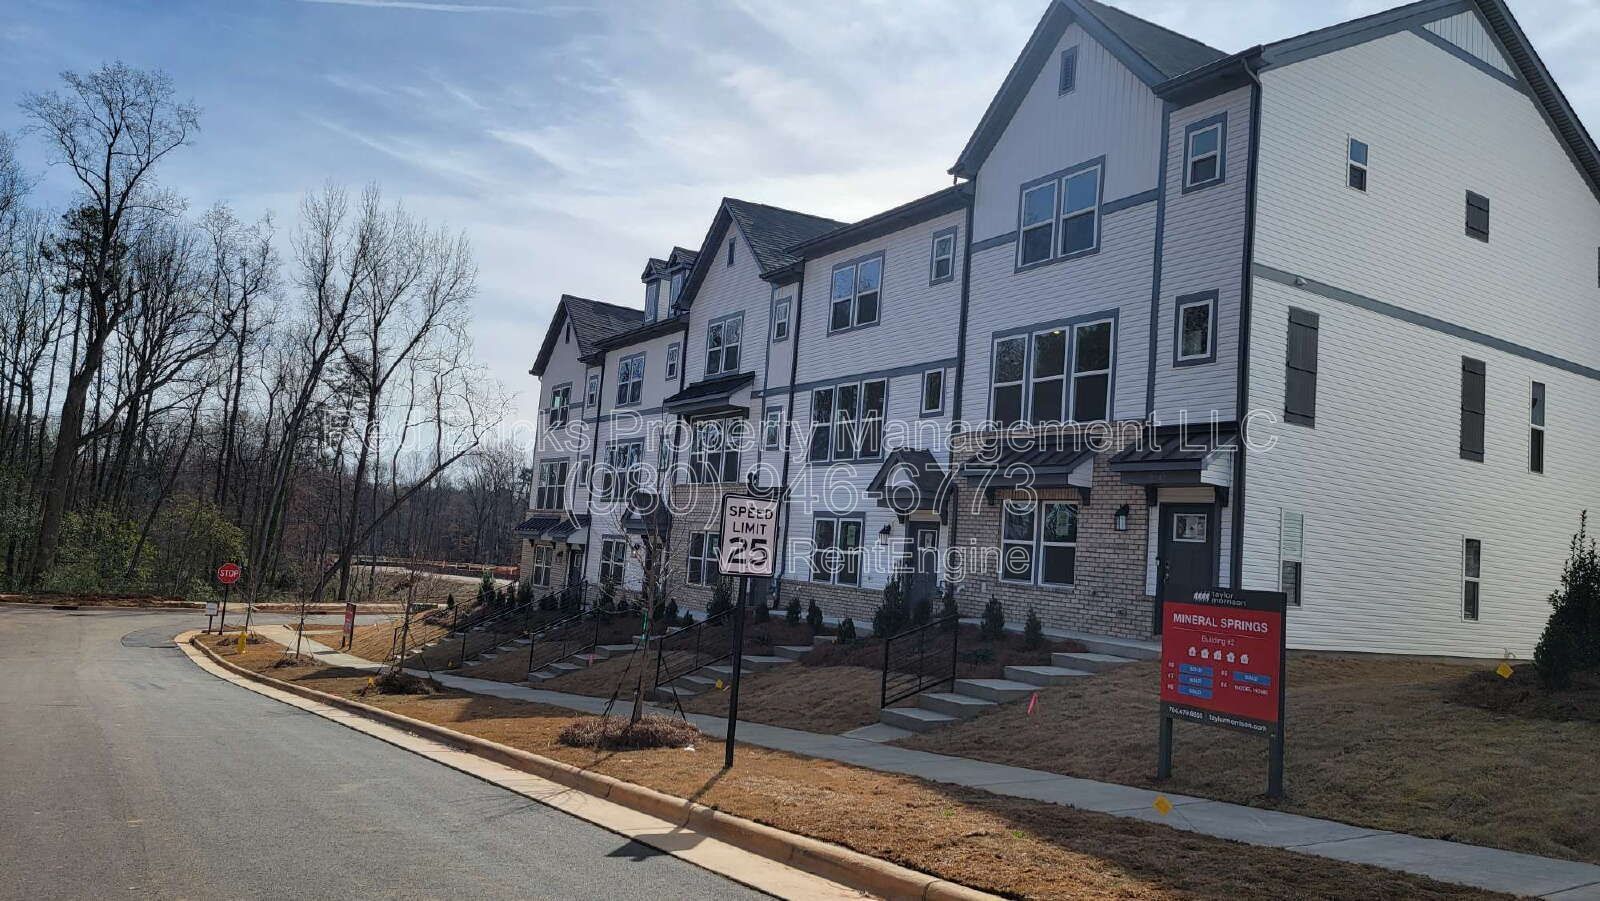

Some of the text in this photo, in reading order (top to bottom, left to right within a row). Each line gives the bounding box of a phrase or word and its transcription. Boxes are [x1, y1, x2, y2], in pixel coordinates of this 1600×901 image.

[729, 505, 774, 520] SPEED
[732, 521, 768, 536] LIMIT
[727, 537, 769, 566] 25
[220, 569, 239, 578] STOP
[1173, 612, 1269, 633] MINERAL SPRINGS
